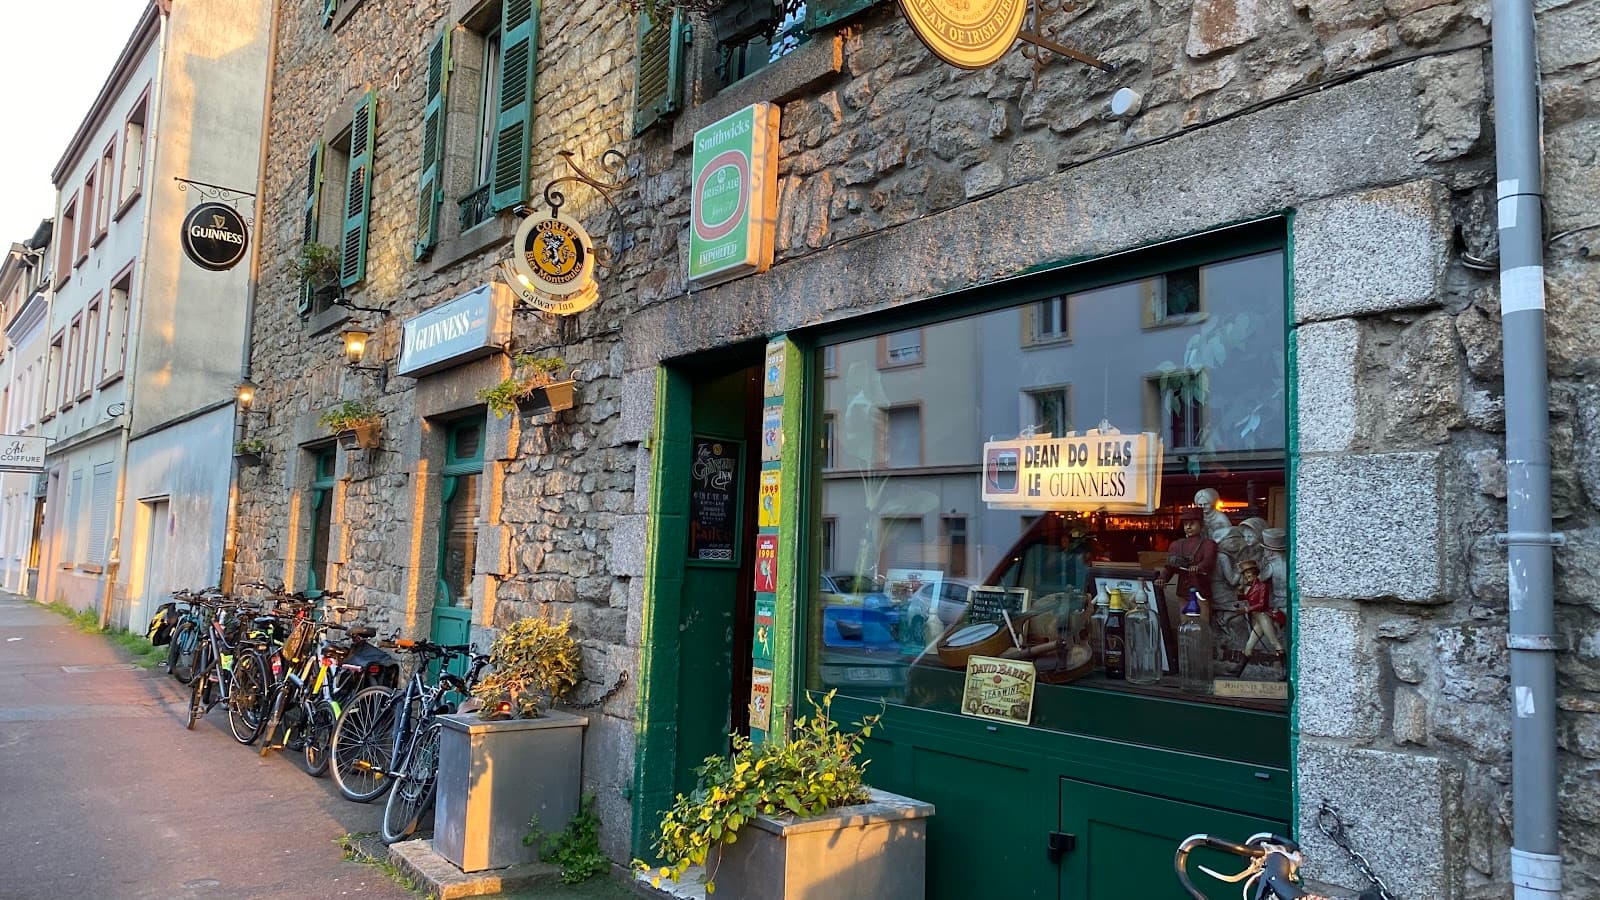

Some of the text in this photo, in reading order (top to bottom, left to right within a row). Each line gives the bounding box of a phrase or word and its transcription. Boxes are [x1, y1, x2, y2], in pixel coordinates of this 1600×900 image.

[917, 0, 946, 35] REAM
[949, 27, 967, 43] OF
[967, 21, 997, 44] IRISH
[994, 0, 1012, 27] BEE
[704, 177, 739, 200] IRISH ALE
[191, 225, 243, 244] GUINNESS
[536, 221, 578, 241] COREFF
[699, 243, 737, 265] IMPORTED
[525, 250, 583, 284] Bier Montroulez
[522, 290, 574, 311] Galway Inn
[415, 310, 470, 352] GUINNESS
[0, 455, 41, 463] COIFFURE
[1024, 441, 1132, 468] DEAN DO LEAS
[761, 484, 778, 495] 1999
[1028, 471, 1126, 497] LE GUINNESS
[970, 663, 1032, 682] DAVID BARRY
[982, 704, 1010, 717] CORK
